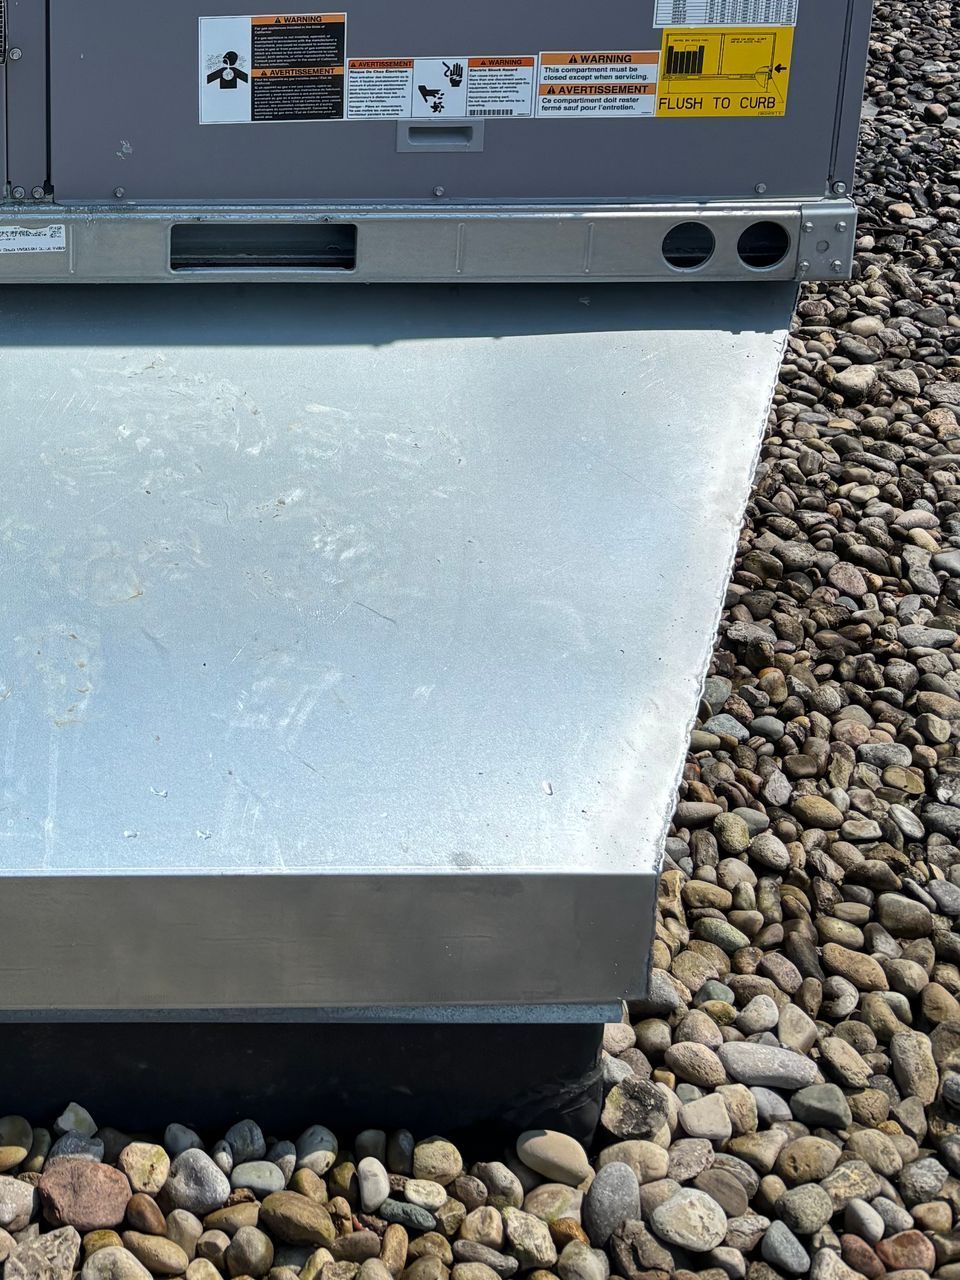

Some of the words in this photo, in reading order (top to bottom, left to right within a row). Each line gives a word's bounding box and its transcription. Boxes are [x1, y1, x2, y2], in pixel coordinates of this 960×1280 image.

[580, 55, 631, 63] WARNING
[270, 68, 335, 76] AVERTISSEMENT
[558, 86, 648, 94] AVERTISSEMENT
[555, 97, 601, 105] compartiment
[659, 97, 703, 110] FLUSH
[713, 97, 731, 109] TO
[740, 97, 775, 109] CURB
